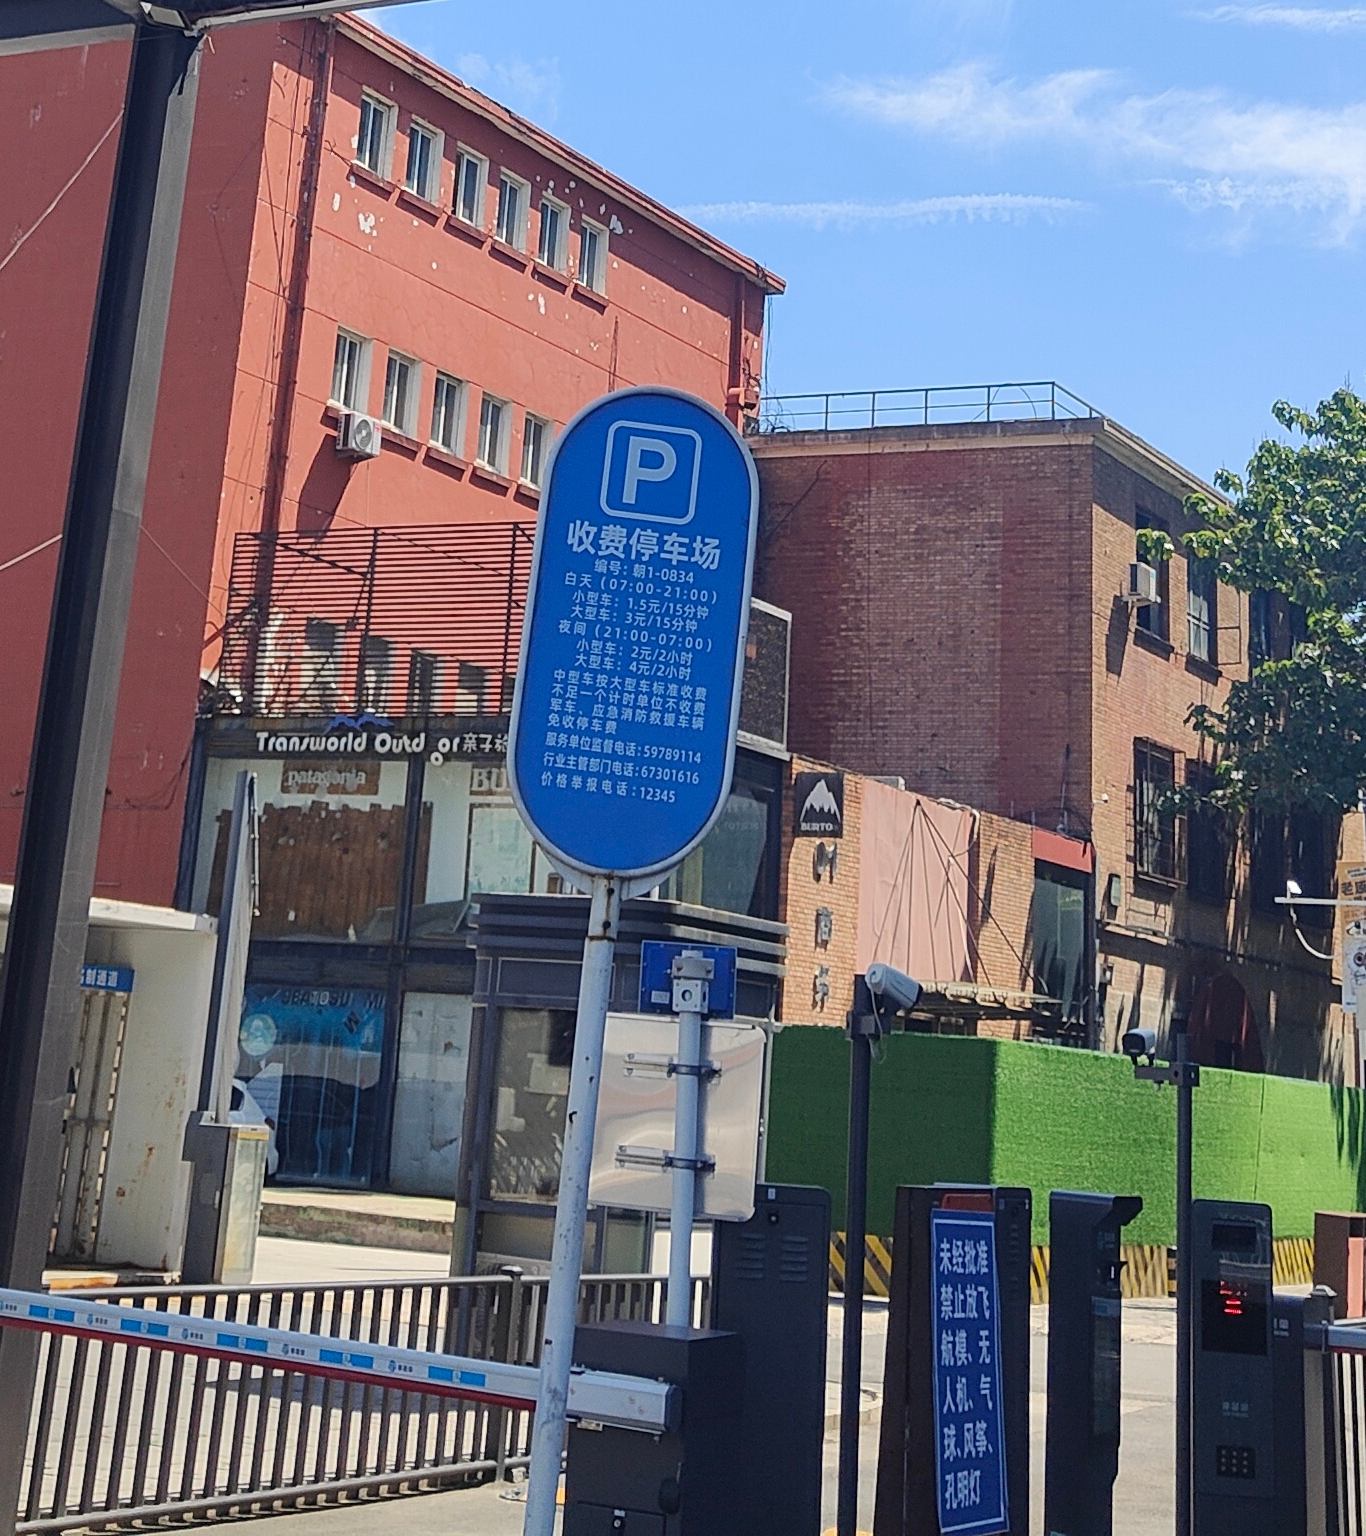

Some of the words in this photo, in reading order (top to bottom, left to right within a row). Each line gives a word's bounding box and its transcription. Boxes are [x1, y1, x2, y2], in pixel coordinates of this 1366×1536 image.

[621, 435, 677, 504] P
[566, 519, 721, 570] 收费停车场
[551, 683, 706, 716] 不足一个计时单位不收费
[553, 668, 707, 702] 中型车按大型车标准收费
[547, 712, 617, 735] 免收停车费
[256, 732, 367, 752] Transworld
[800, 822, 835, 832] BURTO
[939, 1237, 989, 1275] 未经批准
[940, 1283, 990, 1321] 禁止放飞
[944, 1469, 981, 1510] 孔明灯
